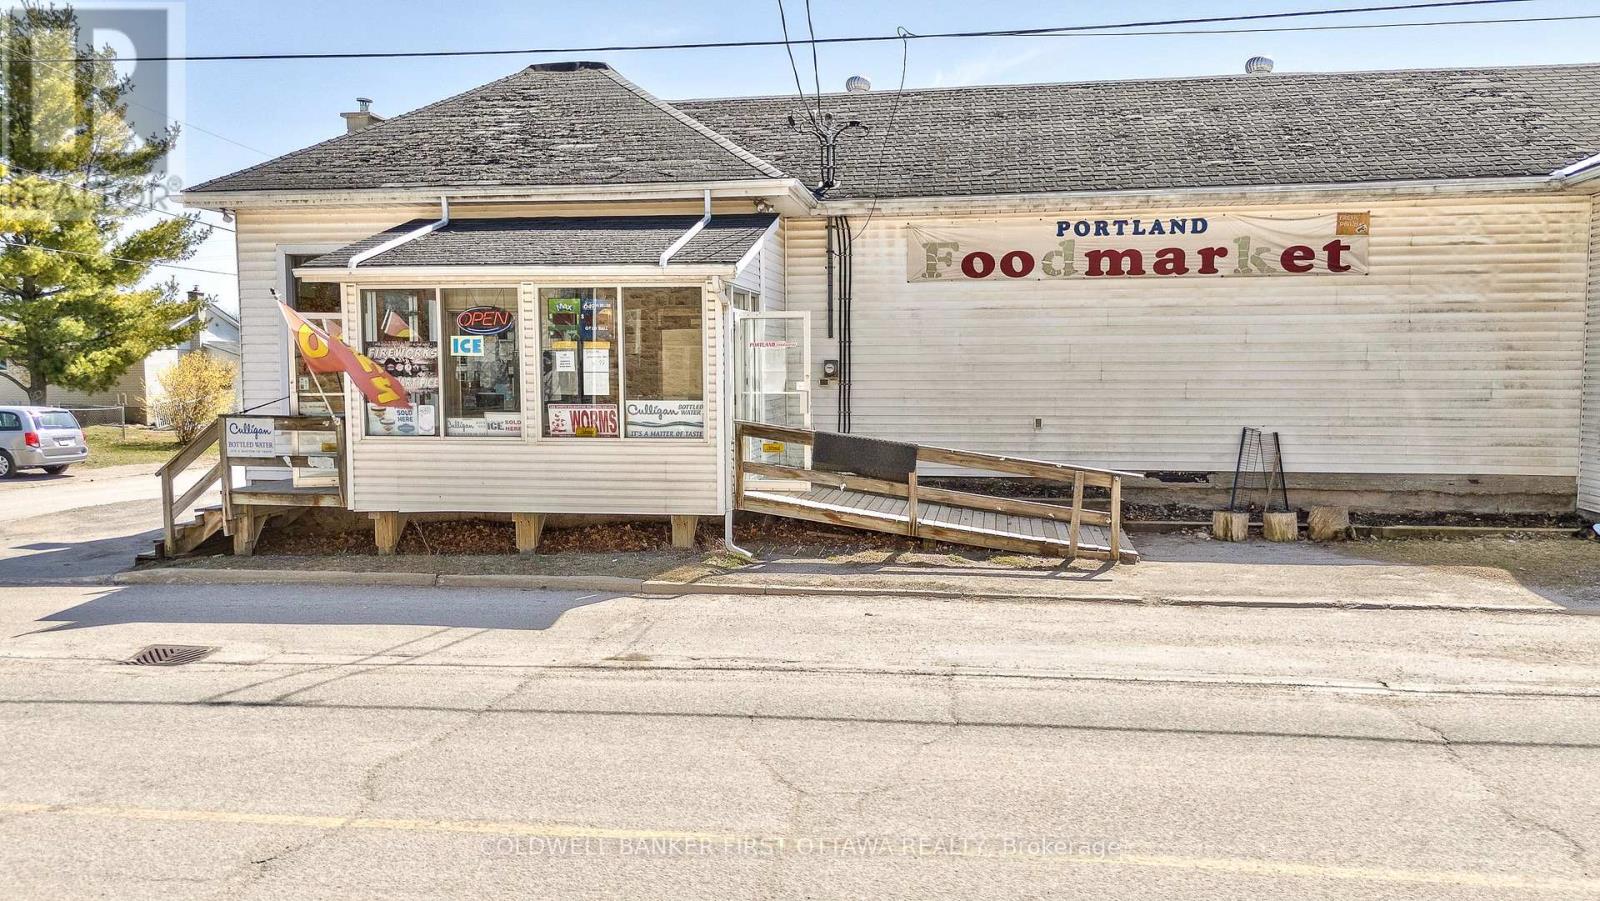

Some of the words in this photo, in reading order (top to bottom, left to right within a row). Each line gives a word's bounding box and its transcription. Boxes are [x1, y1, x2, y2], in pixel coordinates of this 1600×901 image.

[1056, 217, 1208, 237] PORTLAND
[921, 236, 1351, 278] Foodmarket
[459, 311, 509, 327] OPEN
[368, 347, 438, 360] FIREWORKS
[453, 338, 482, 354] ICE
[627, 403, 679, 420] Culligan
[487, 421, 504, 431] ICE
[569, 409, 618, 433] WORMS
[229, 422, 272, 440] Culligan
